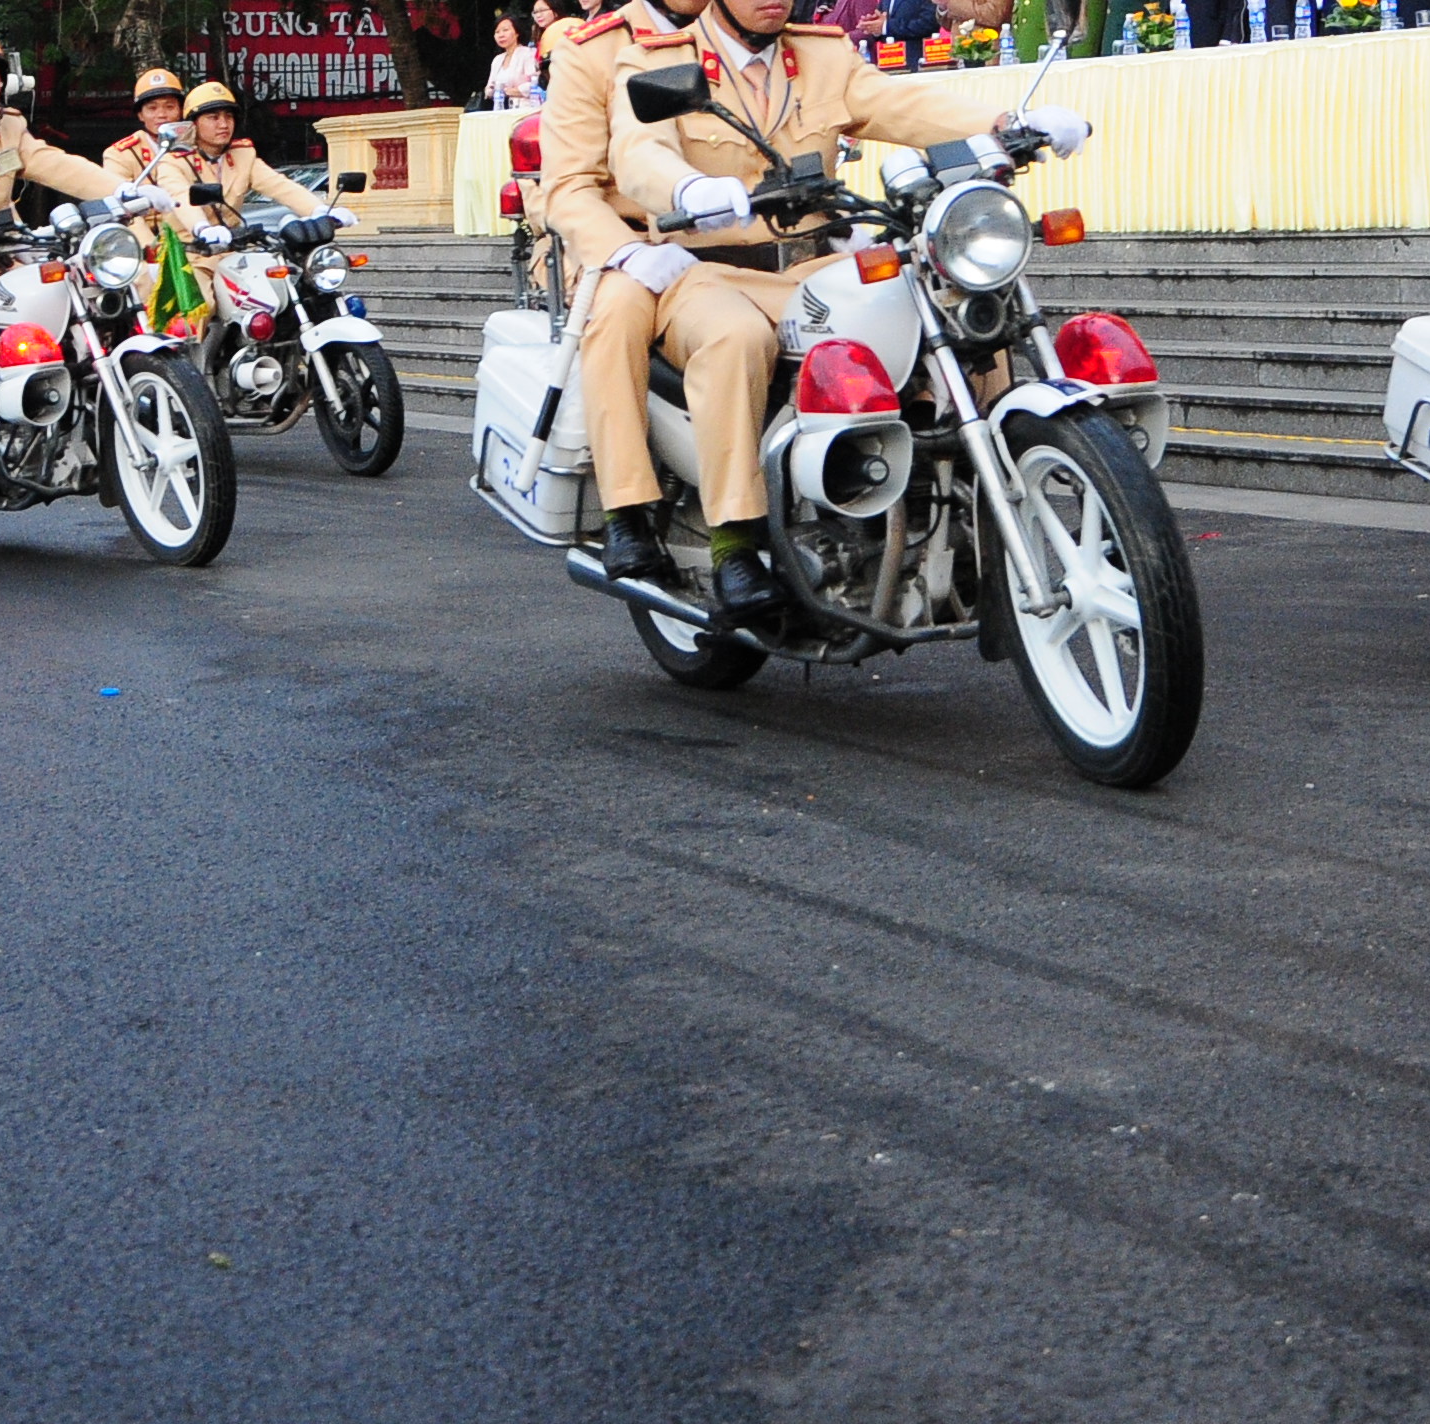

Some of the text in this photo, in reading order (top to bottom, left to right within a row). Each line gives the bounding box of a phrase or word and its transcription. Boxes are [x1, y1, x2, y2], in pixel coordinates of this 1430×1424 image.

[202, 7, 387, 37] RUNG TÂ
[253, 51, 320, 110] CHỌN
[325, 37, 367, 97] HẢI
